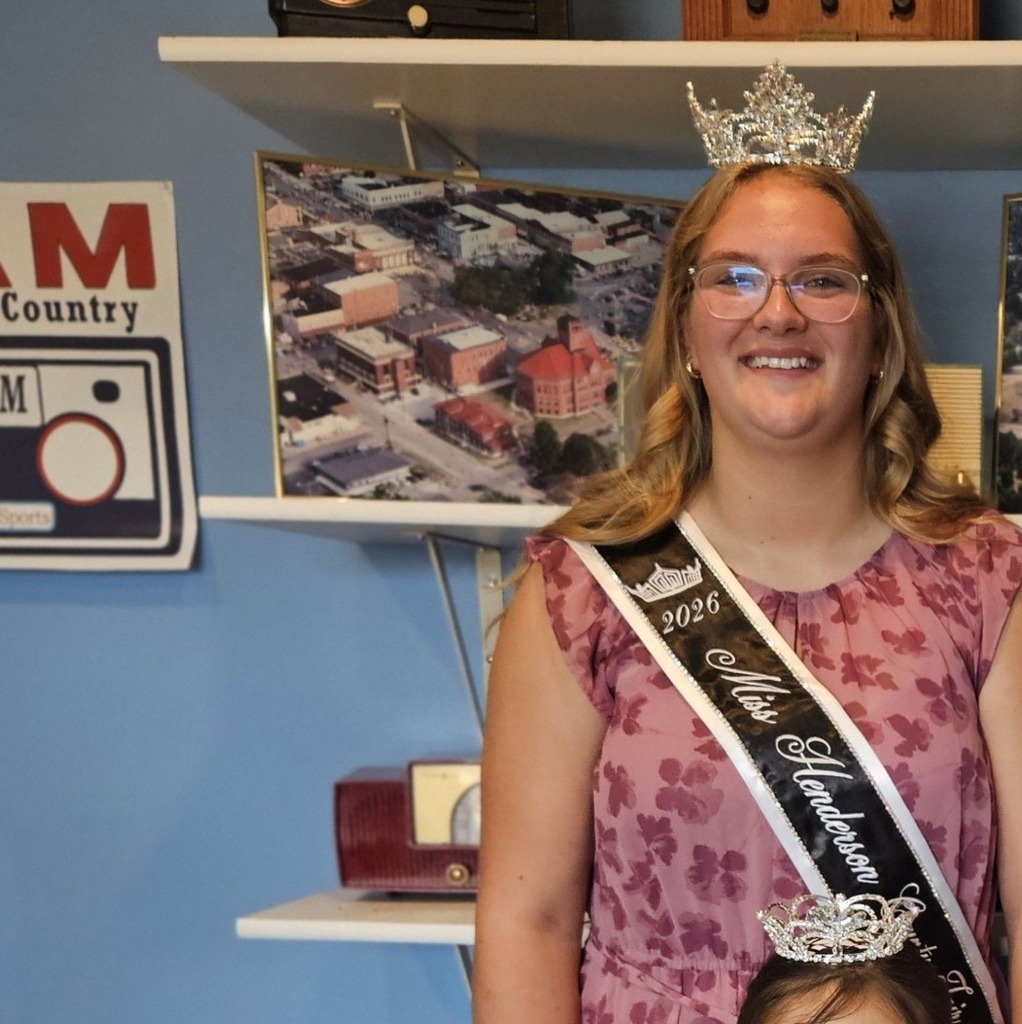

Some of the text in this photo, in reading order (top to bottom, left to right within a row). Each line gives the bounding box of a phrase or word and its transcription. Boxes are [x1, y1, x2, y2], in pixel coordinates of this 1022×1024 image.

[0, 203, 156, 289] M
[1, 291, 138, 333] Country
[661, 591, 721, 635] 2026
[705, 648, 791, 725] Miss
[775, 734, 880, 885] Henderson
